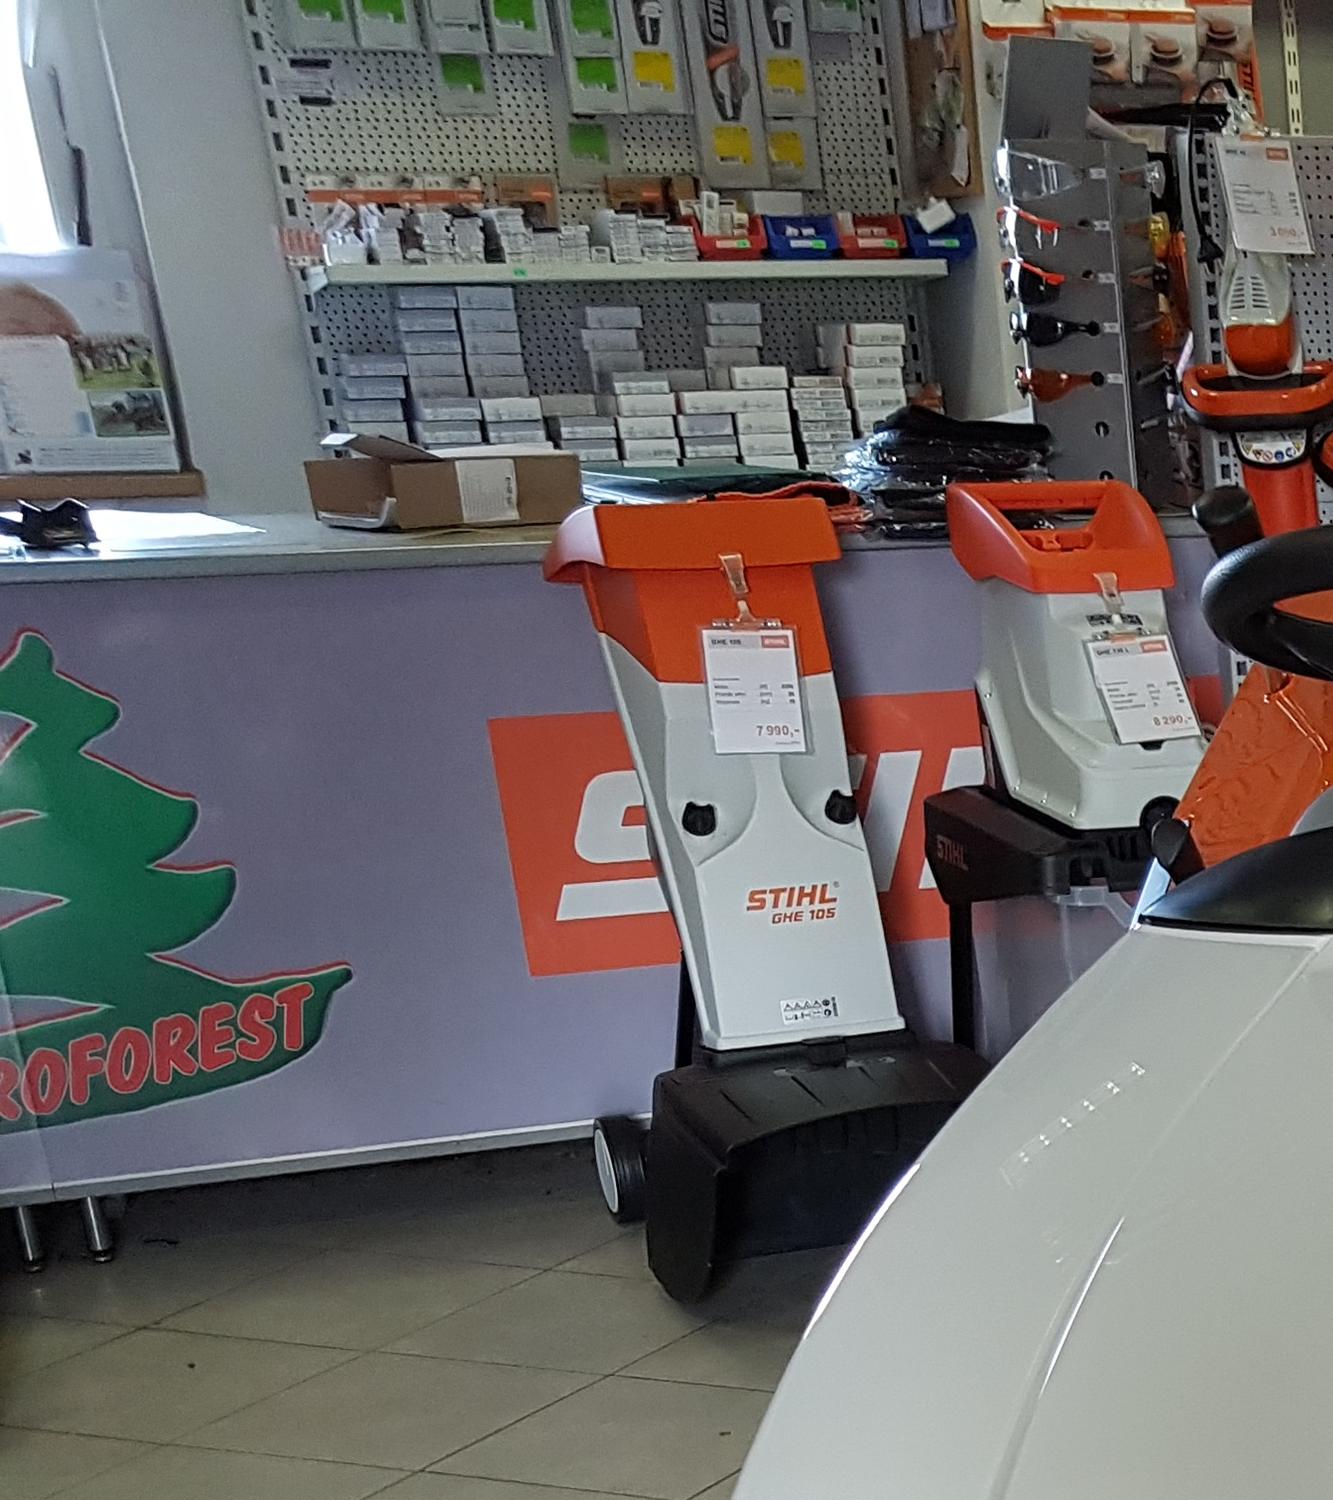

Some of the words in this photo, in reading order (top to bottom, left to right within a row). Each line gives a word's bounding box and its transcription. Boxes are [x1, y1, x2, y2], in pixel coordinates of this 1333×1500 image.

[756, 725, 764, 736] 7
[936, 834, 969, 872] STIHL
[746, 882, 838, 912] STIHL
[772, 910, 804, 925] GHE
[809, 907, 836, 921] 105
